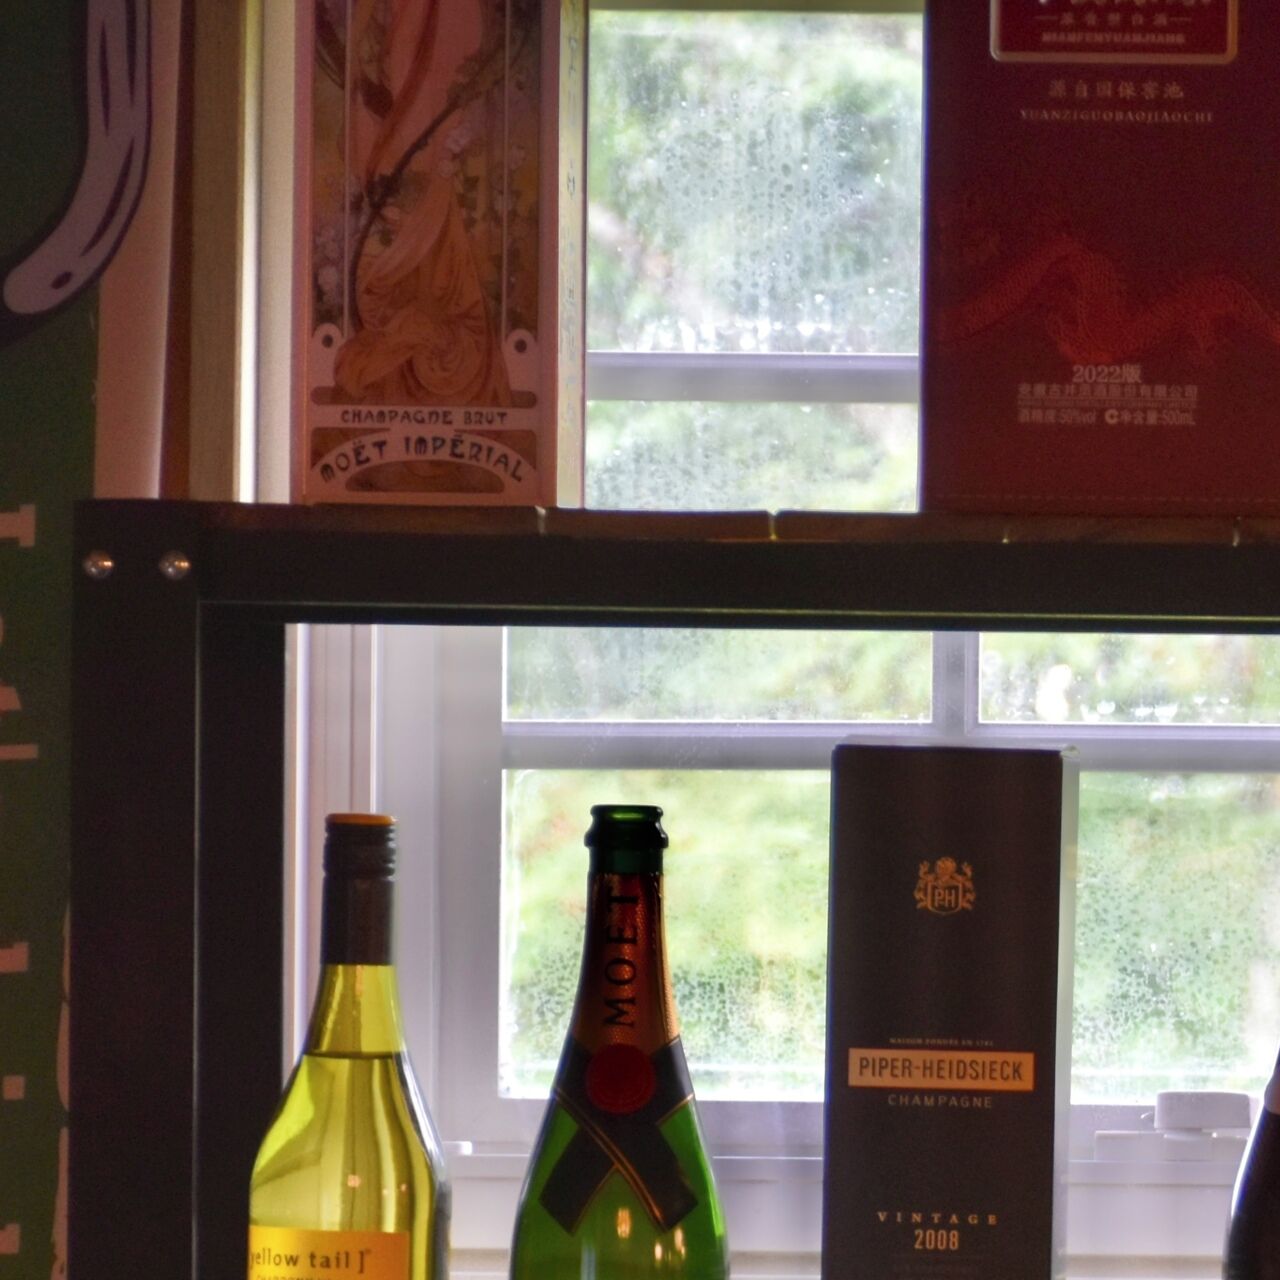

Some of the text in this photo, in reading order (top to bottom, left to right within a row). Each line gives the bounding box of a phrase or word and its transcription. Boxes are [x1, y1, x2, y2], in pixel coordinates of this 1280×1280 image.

[341, 410, 508, 426] CHAMPAGNE BRUT
[858, 1057, 1023, 1081] PIPER-HEIDSIECK
[887, 1093, 993, 1109] CHAMPAGNE
[877, 1211, 998, 1225] VINTAGE
[914, 1229, 959, 1249] 2008
[308, 1251, 350, 1269] tail
